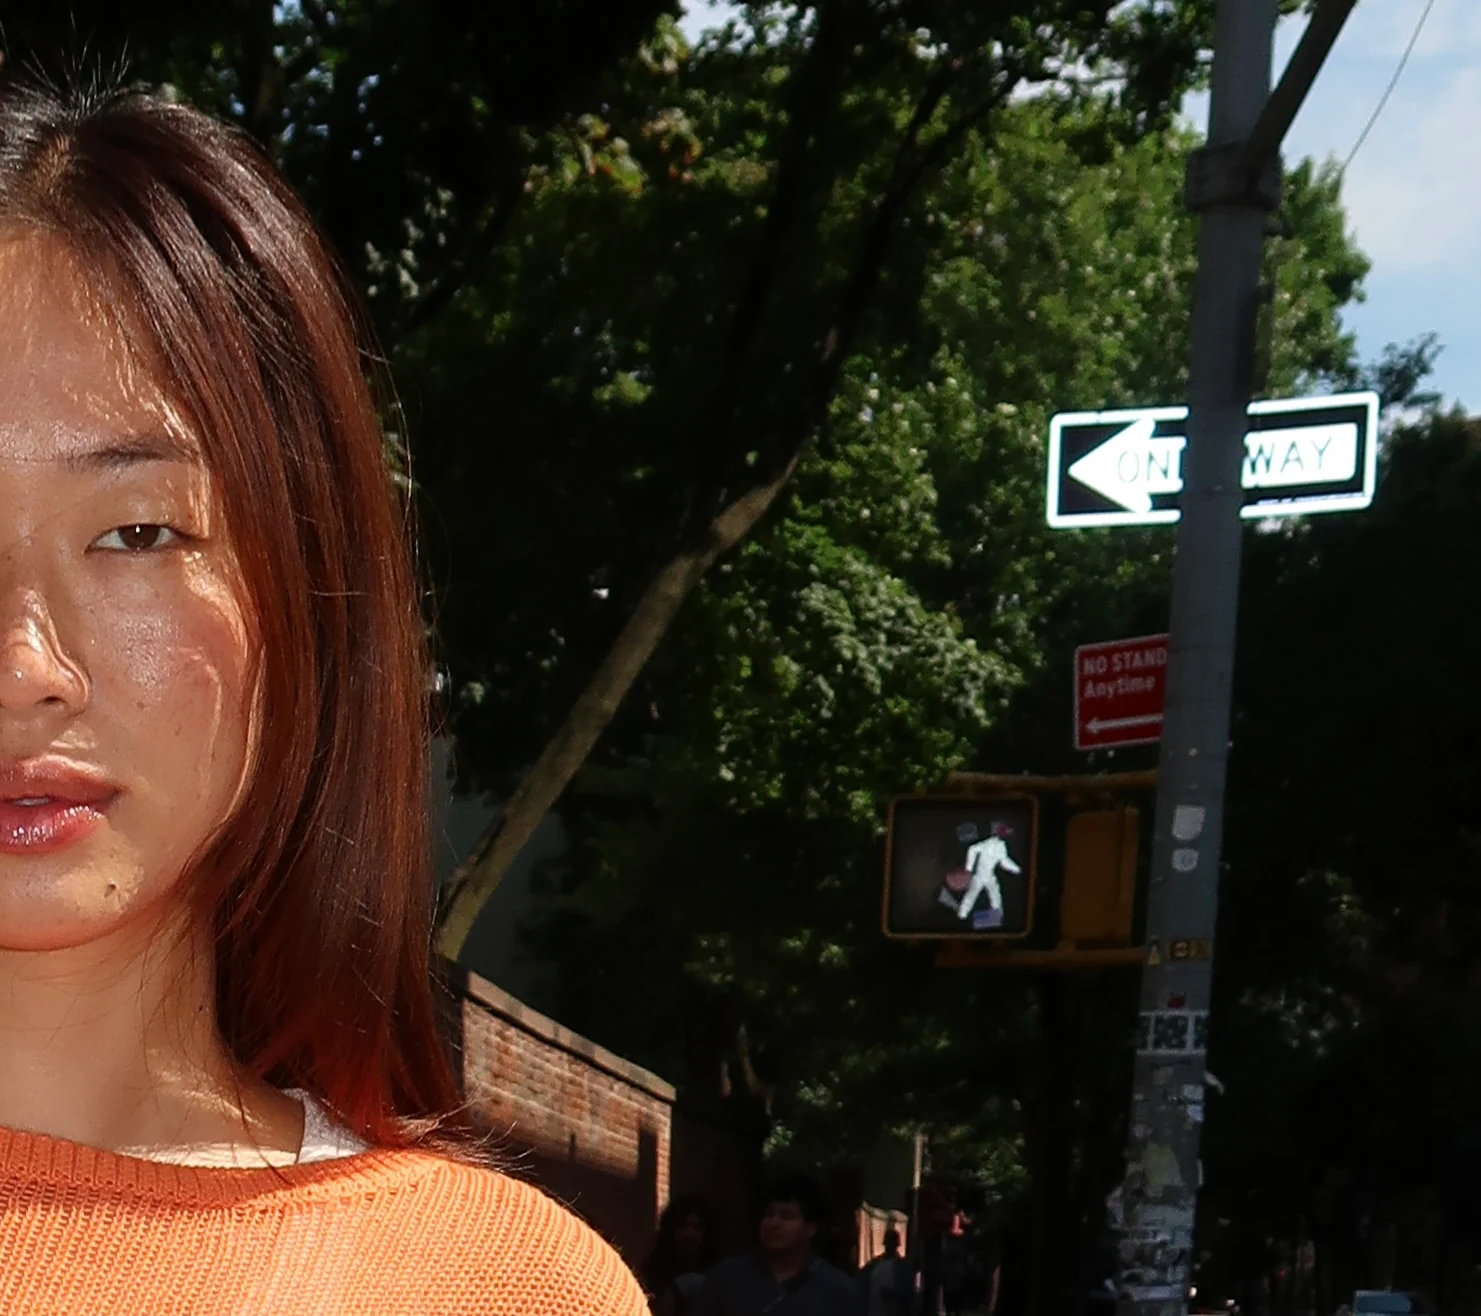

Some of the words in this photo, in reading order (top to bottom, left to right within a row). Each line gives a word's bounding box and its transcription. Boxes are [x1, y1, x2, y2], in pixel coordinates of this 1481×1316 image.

[1118, 449, 1182, 484] ON
[1247, 437, 1333, 476] WAY
[1083, 655, 1108, 675] NO
[1111, 647, 1168, 672] STAND
[1083, 675, 1156, 699] Anytime
